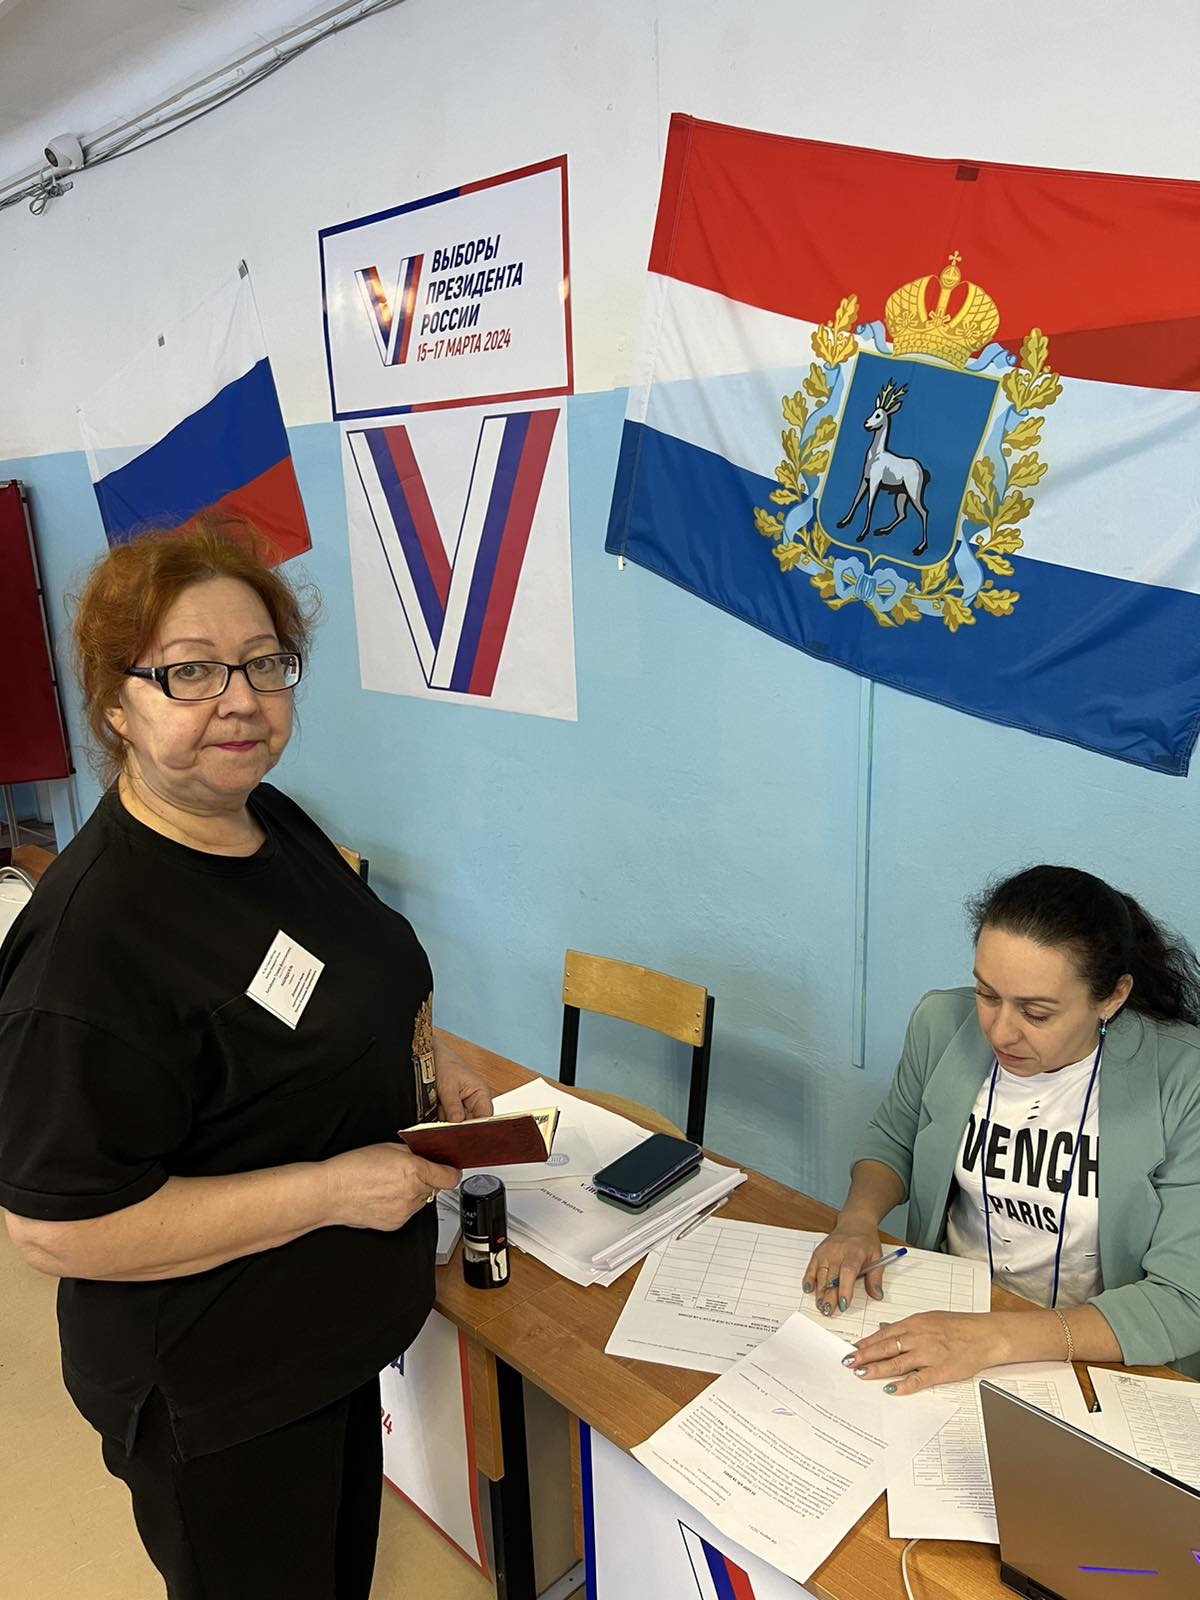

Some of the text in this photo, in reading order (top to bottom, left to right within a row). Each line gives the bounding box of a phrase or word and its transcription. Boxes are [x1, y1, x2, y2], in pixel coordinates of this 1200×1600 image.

[431, 234, 501, 273] ВЫБОРЫ
[426, 262, 523, 305] ПРЕЗИДЕНТА
[420, 303, 480, 336] РОССИИ
[445, 333, 482, 357] МАРТА
[483, 328, 511, 352] 2024
[987, 1194, 1059, 1234] PARIS
